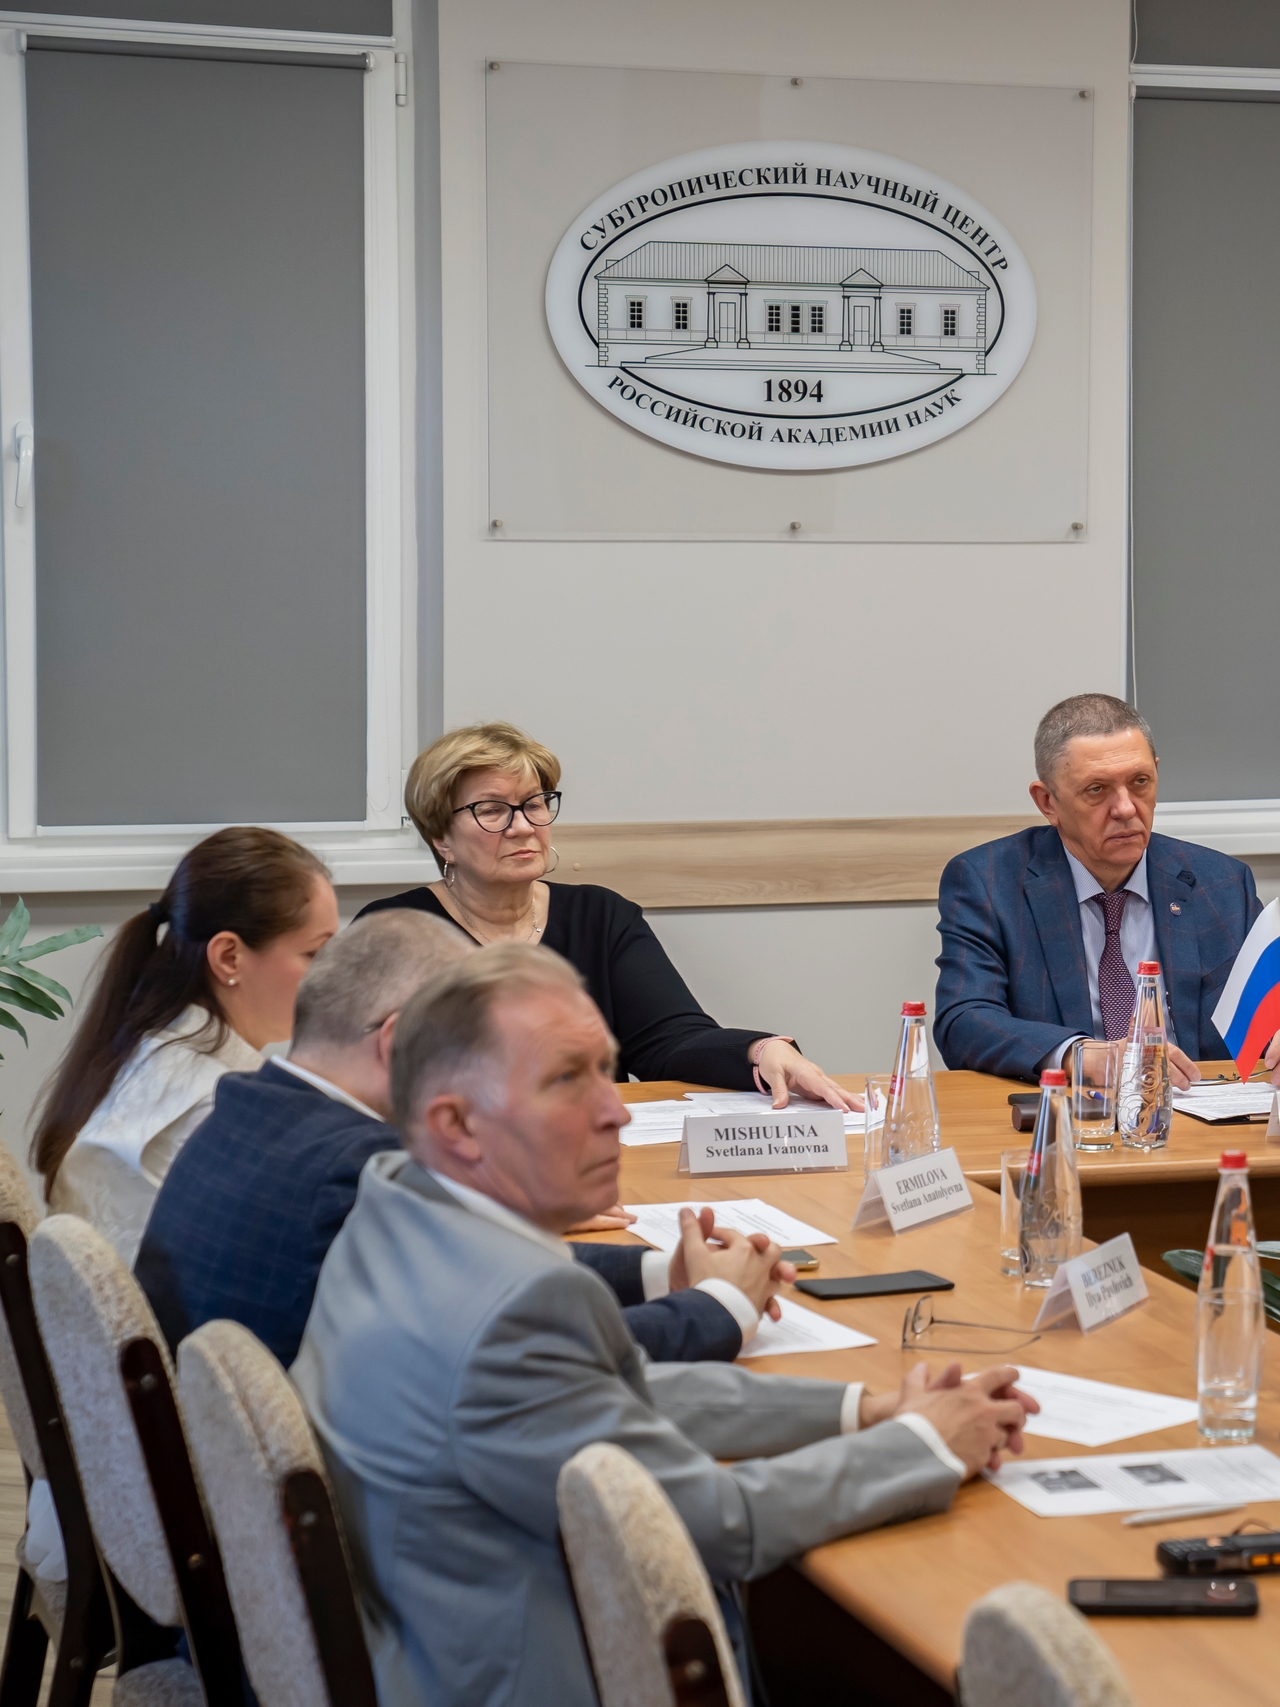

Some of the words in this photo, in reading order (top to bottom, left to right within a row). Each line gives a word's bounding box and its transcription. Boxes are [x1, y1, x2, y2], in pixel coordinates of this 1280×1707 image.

[580, 162, 809, 252] СУБТРОПИЧЕСКИЙ
[814, 168, 940, 214] НАУЧНЫЙ
[941, 203, 1009, 272] ЦЕНТР
[763, 378, 824, 403] 1894
[606, 374, 764, 443] РОССИЙСКОЙ
[769, 417, 900, 447] АКАДЕМИИ
[905, 388, 964, 431] НАУК
[714, 1124, 819, 1142] MISHULINA
[706, 1145, 763, 1159] Svetlana
[768, 1143, 829, 1155] Ivanovna
[895, 1167, 948, 1196] ERMILOVA
[890, 1196, 922, 1215] Svetlana
[922, 1182, 964, 1205] Anatolyevna
